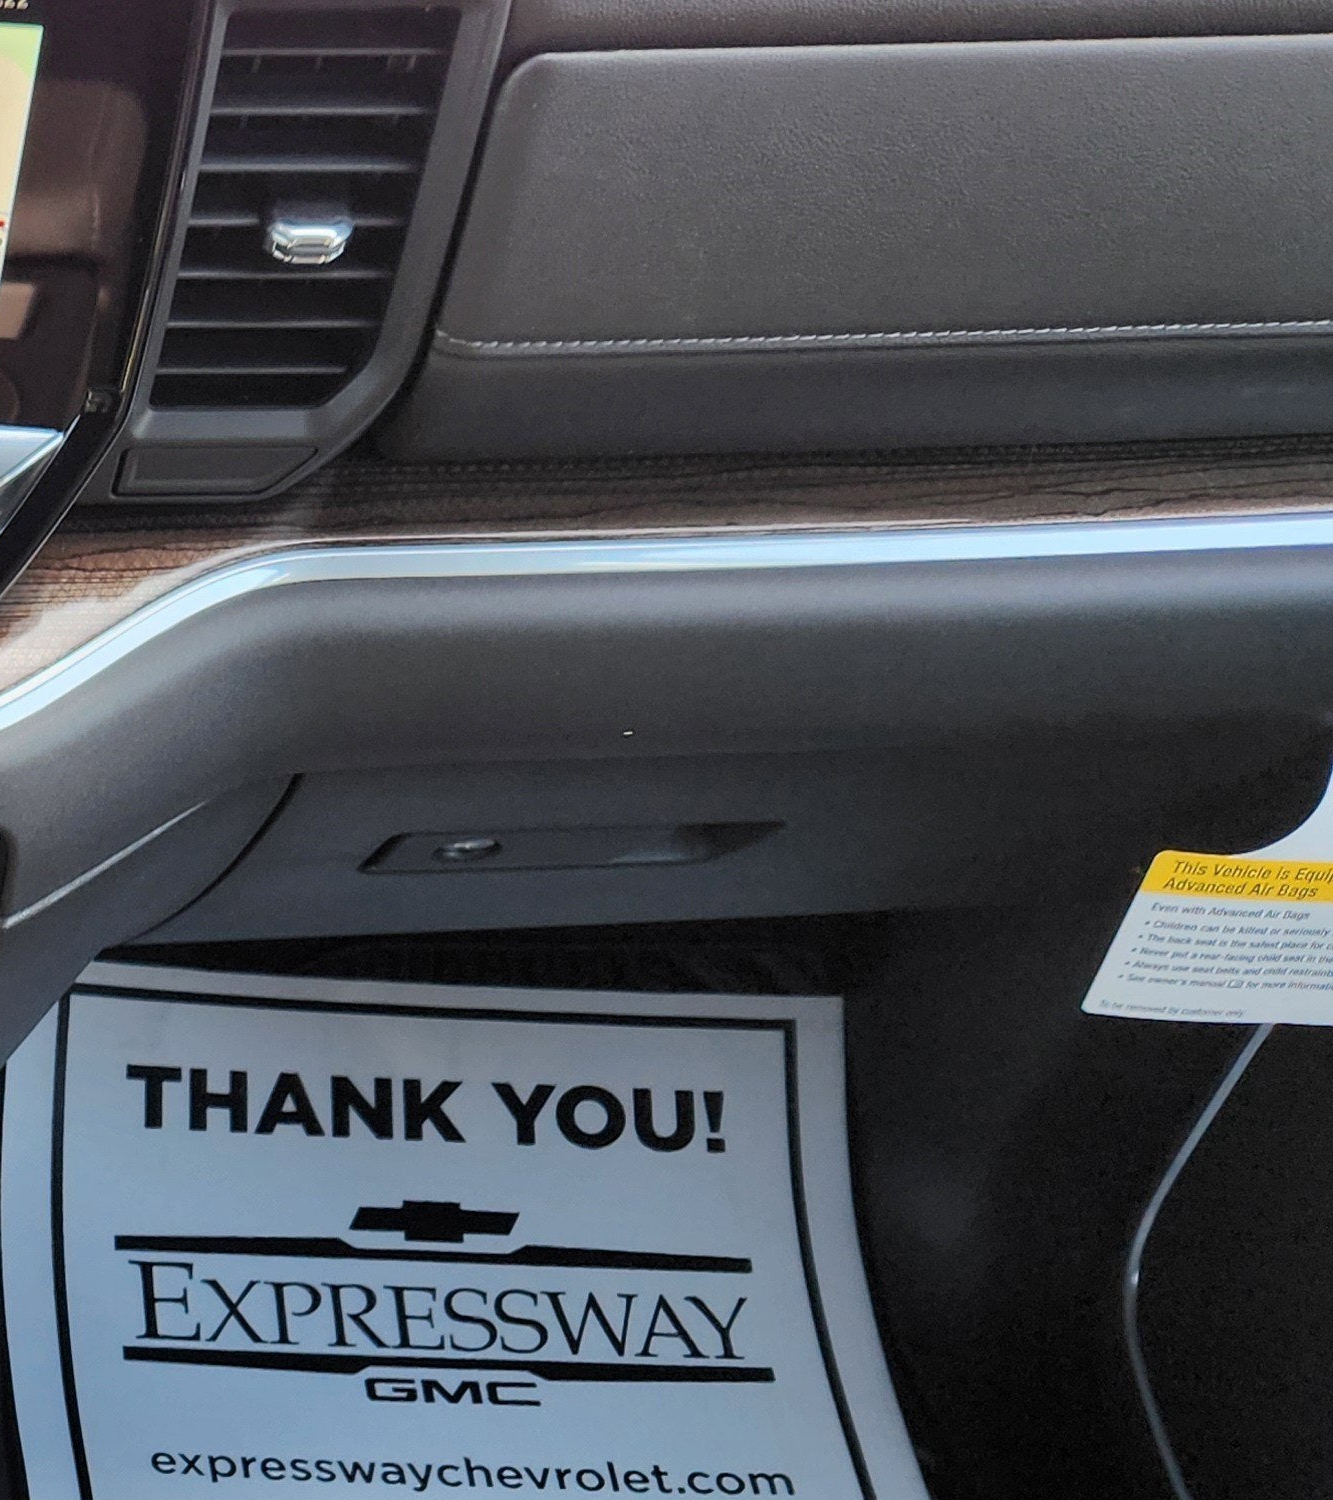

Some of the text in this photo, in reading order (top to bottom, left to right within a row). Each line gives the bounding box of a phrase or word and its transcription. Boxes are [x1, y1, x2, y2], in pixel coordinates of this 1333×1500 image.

[1173, 862, 1207, 876] This
[1214, 864, 1272, 880] Vehicle
[1276, 866, 1290, 880] is
[1163, 877, 1318, 899] Advanced Air Bags
[1151, 902, 1310, 921] Even with Advanced Air Bags
[1153, 920, 1197, 932] Children
[1238, 926, 1268, 934] killed
[126, 1065, 726, 1154] THANK YOU!
[127, 1259, 748, 1363] EXPRESSWAY
[365, 1376, 542, 1407] GMC
[151, 1444, 796, 1499] expresswaychevrolet.com
